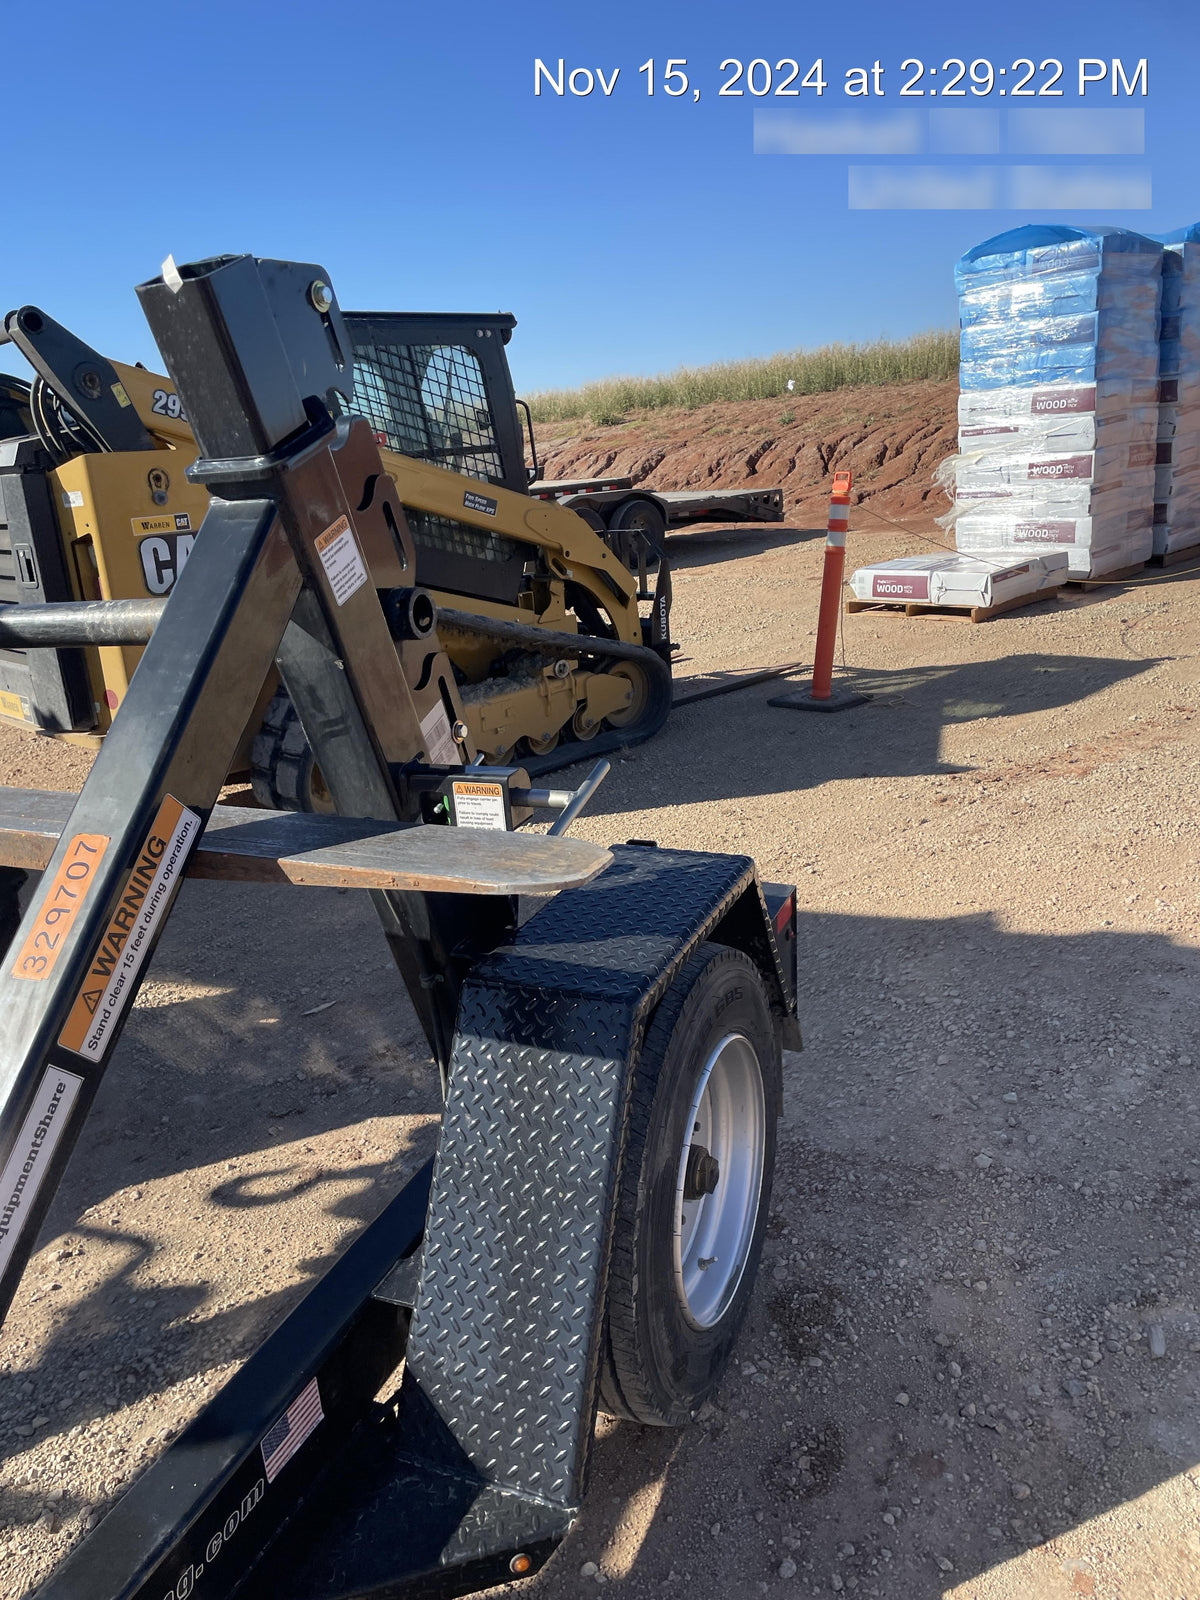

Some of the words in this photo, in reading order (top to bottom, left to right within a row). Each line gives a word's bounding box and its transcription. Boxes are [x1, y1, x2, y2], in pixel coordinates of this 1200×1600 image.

[152, 389, 189, 422] 29
[1036, 399, 1067, 410] WOOD
[1033, 464, 1063, 475] WOOD
[141, 521, 171, 530] WARREN
[175, 517, 188, 527] CAT
[322, 519, 348, 545] WARNING
[1020, 529, 1049, 538] WOOD
[140, 534, 196, 594] CA
[876, 584, 904, 593] WOOD
[659, 595, 667, 640] KUBOTA
[464, 785, 500, 795] WARNING
[23, 840, 99, 974] 329707
[92, 835, 168, 977] WARNING
[88, 1009, 112, 1050] Stand
[109, 971, 127, 1006] clear
[123, 953, 136, 969] 15
[130, 924, 147, 954] feet
[144, 883, 168, 924] during
[162, 820, 193, 880] operation.
[0, 1081, 67, 1244] quipmentShare
[163, 1478, 265, 1600] g.com
